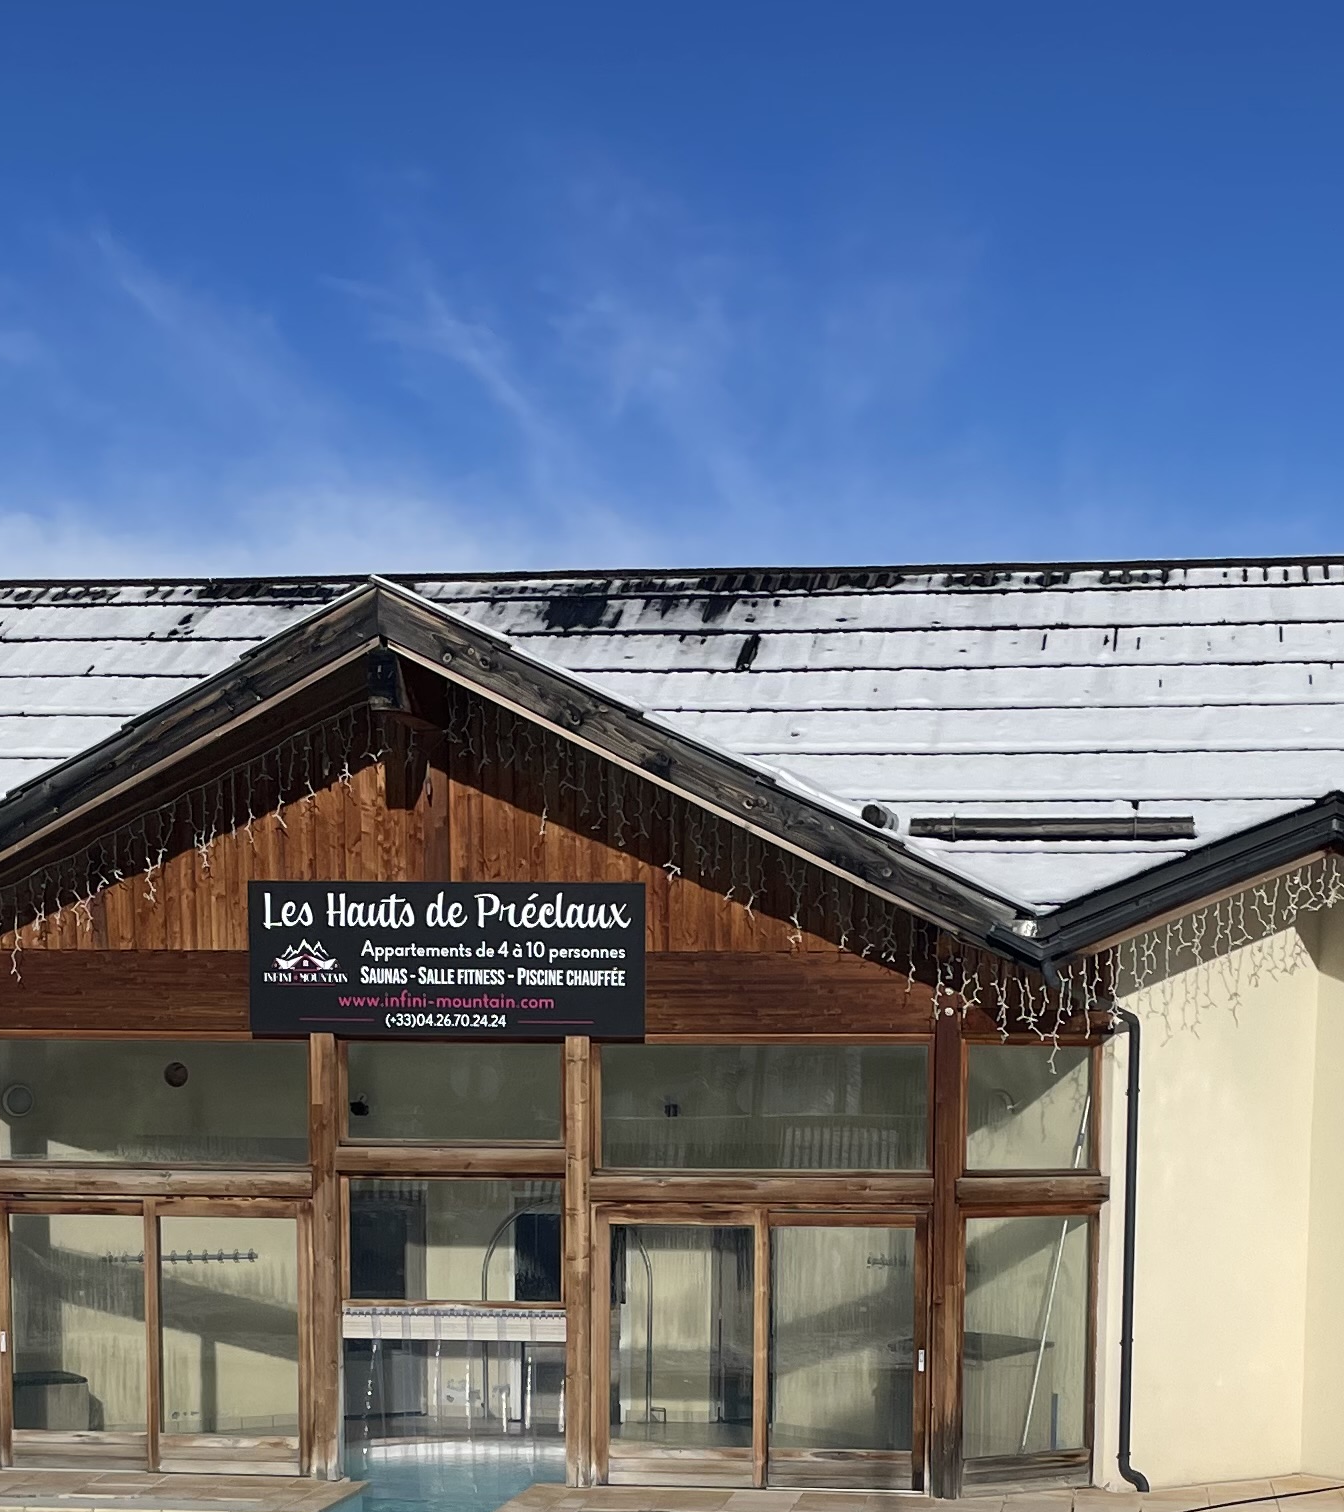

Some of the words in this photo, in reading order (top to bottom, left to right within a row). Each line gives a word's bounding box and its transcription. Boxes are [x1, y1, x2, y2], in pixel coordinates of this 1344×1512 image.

[263, 892, 314, 929] Les
[326, 892, 415, 929] Hauts
[425, 890, 468, 928] de
[473, 892, 632, 929] Préclaux
[360, 939, 473, 962] Appartements
[475, 940, 495, 958] de
[497, 940, 509, 958] 4
[512, 943, 523, 958] à
[525, 940, 545, 958] 10
[548, 948, 626, 964] personnes
[299, 972, 348, 983] MOUNTAIN
[360, 965, 408, 985] SAUNAS
[418, 966, 456, 985] SALLE
[457, 968, 505, 986] FITNESS
[517, 967, 564, 986] PISCINE
[566, 966, 626, 987] CHAUFFÉE
[338, 989, 555, 1009] www.infini-mountain.com
[385, 1013, 507, 1028] (+33)04.26.70.24.24
